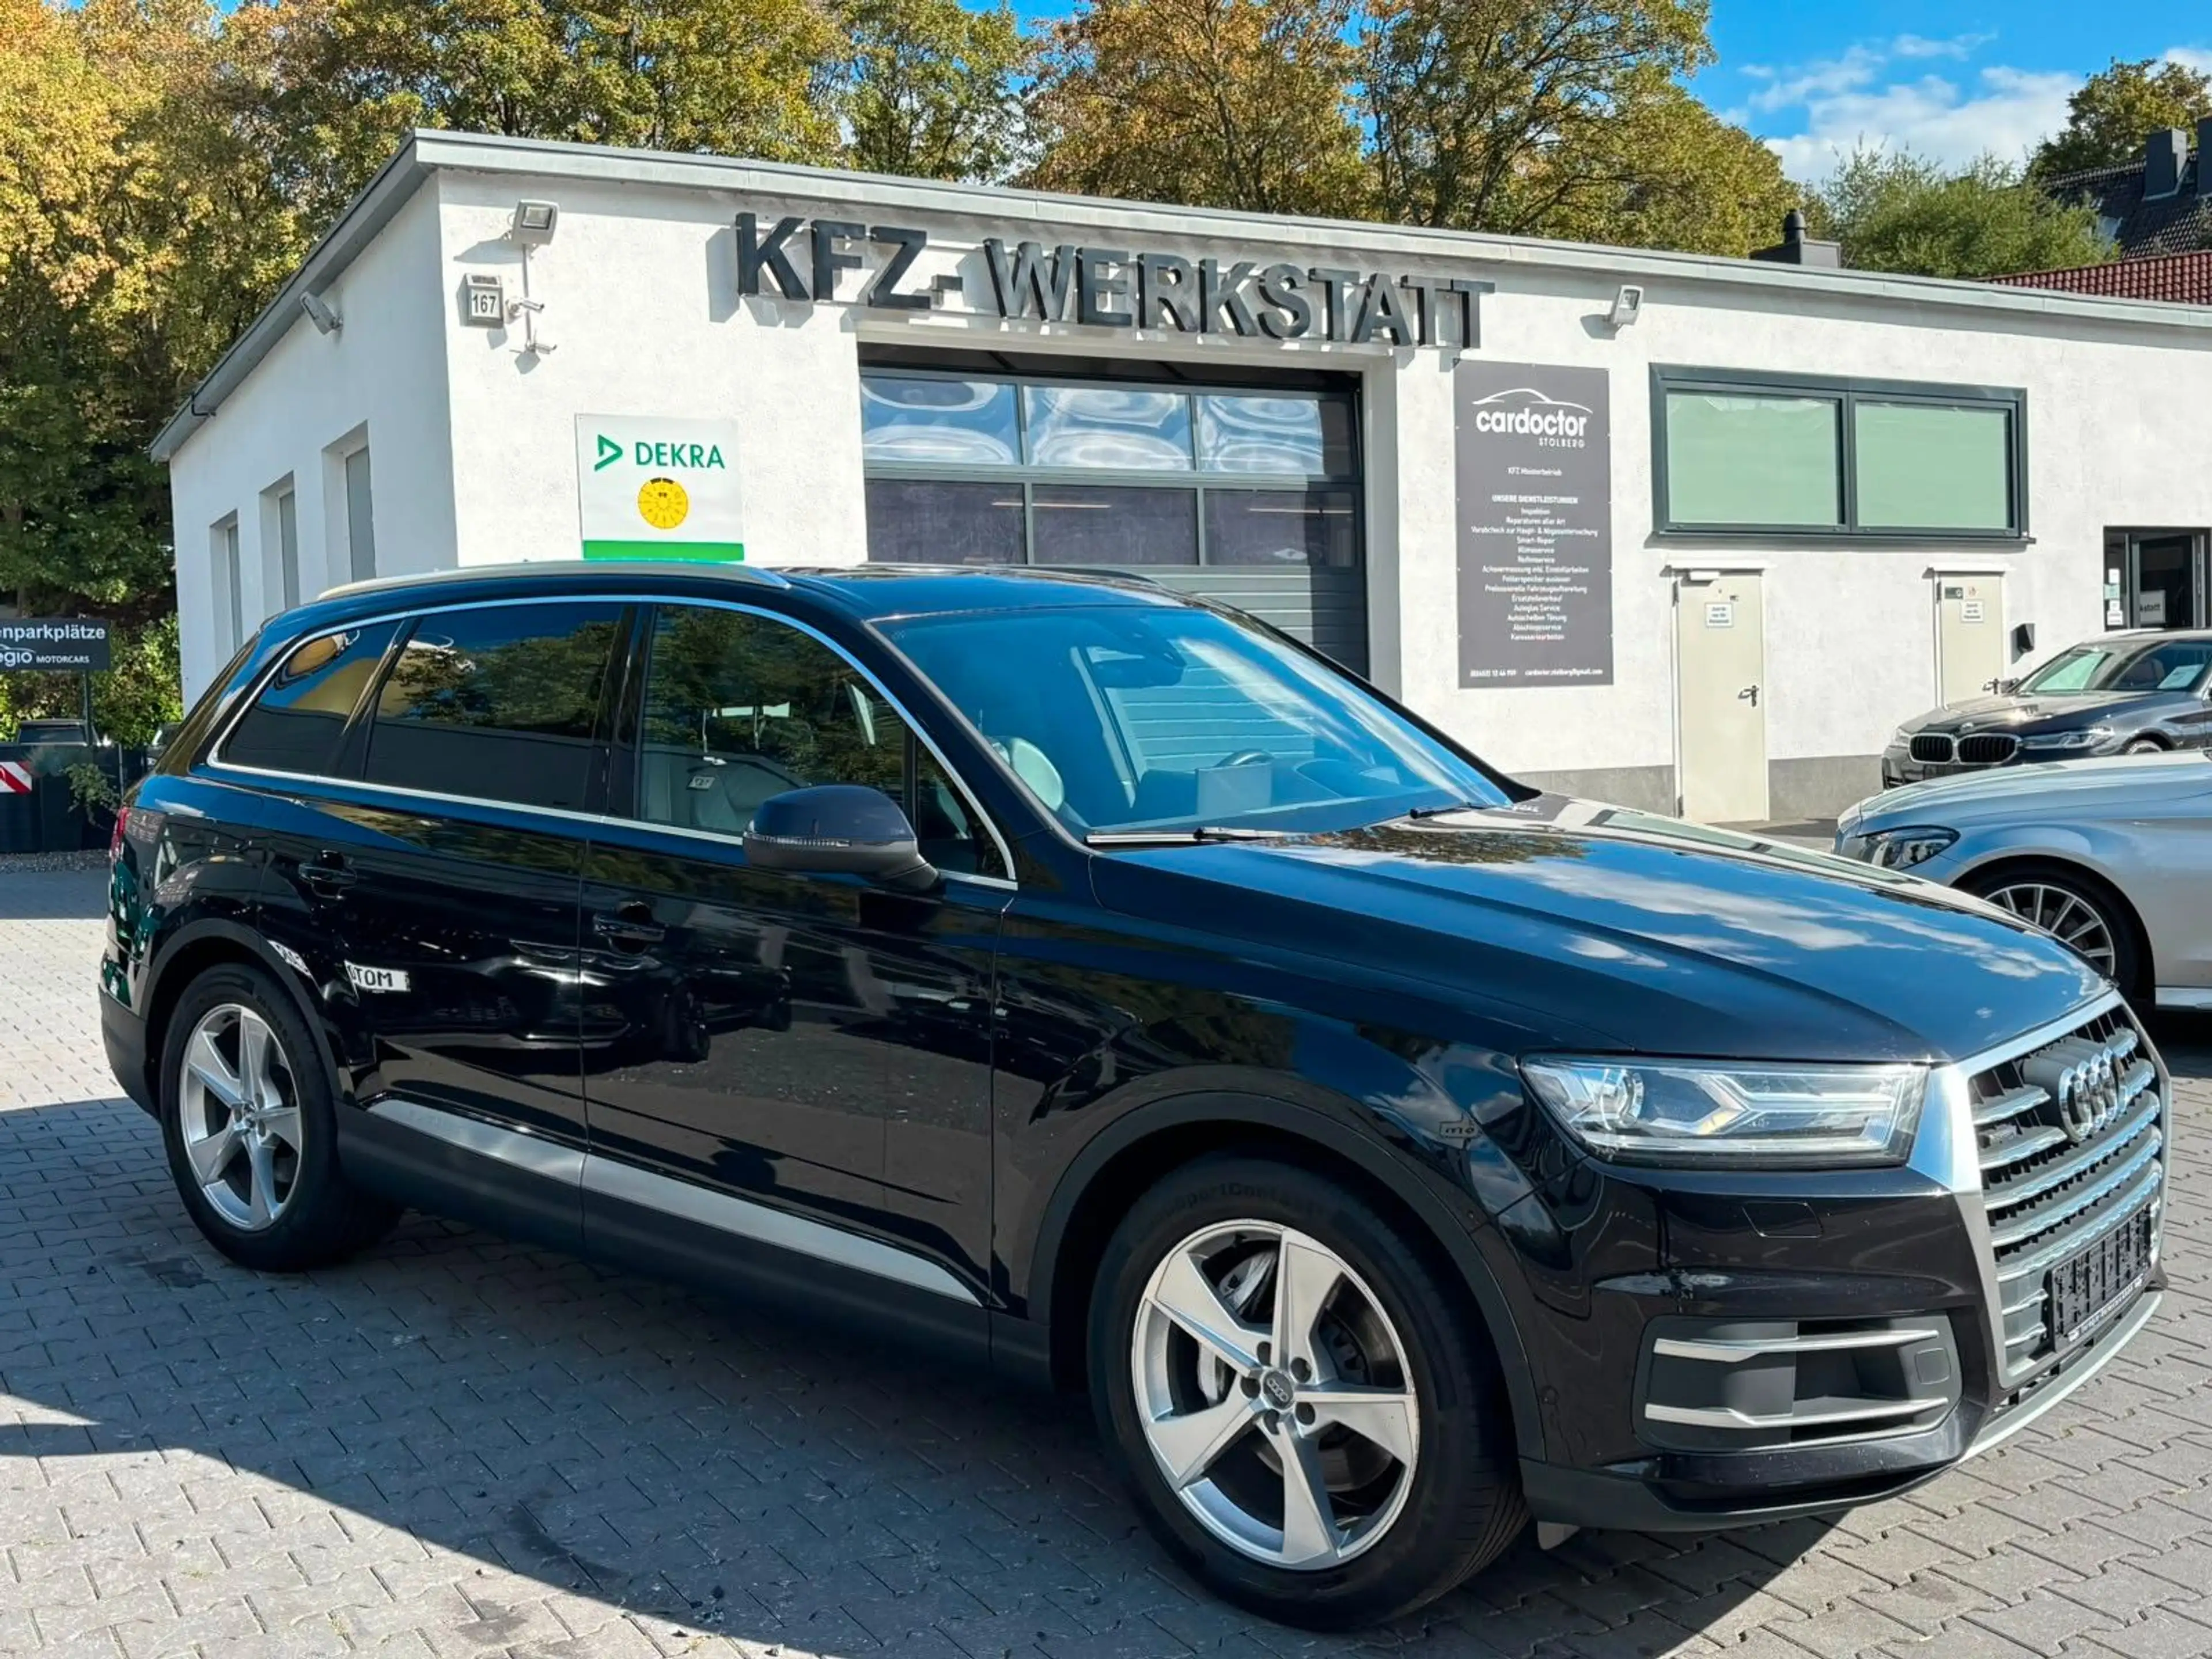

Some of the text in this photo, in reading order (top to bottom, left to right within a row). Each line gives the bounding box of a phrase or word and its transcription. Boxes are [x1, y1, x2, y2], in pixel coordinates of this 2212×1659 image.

[472, 293, 497, 314] 167
[1476, 408, 1587, 437] cardoctor
[1538, 437, 1585, 448] STOLBERG
[635, 441, 725, 469] DEKRA
[0, 624, 106, 642] nparkplätze
[36, 655, 90, 664] MOTORCARS
